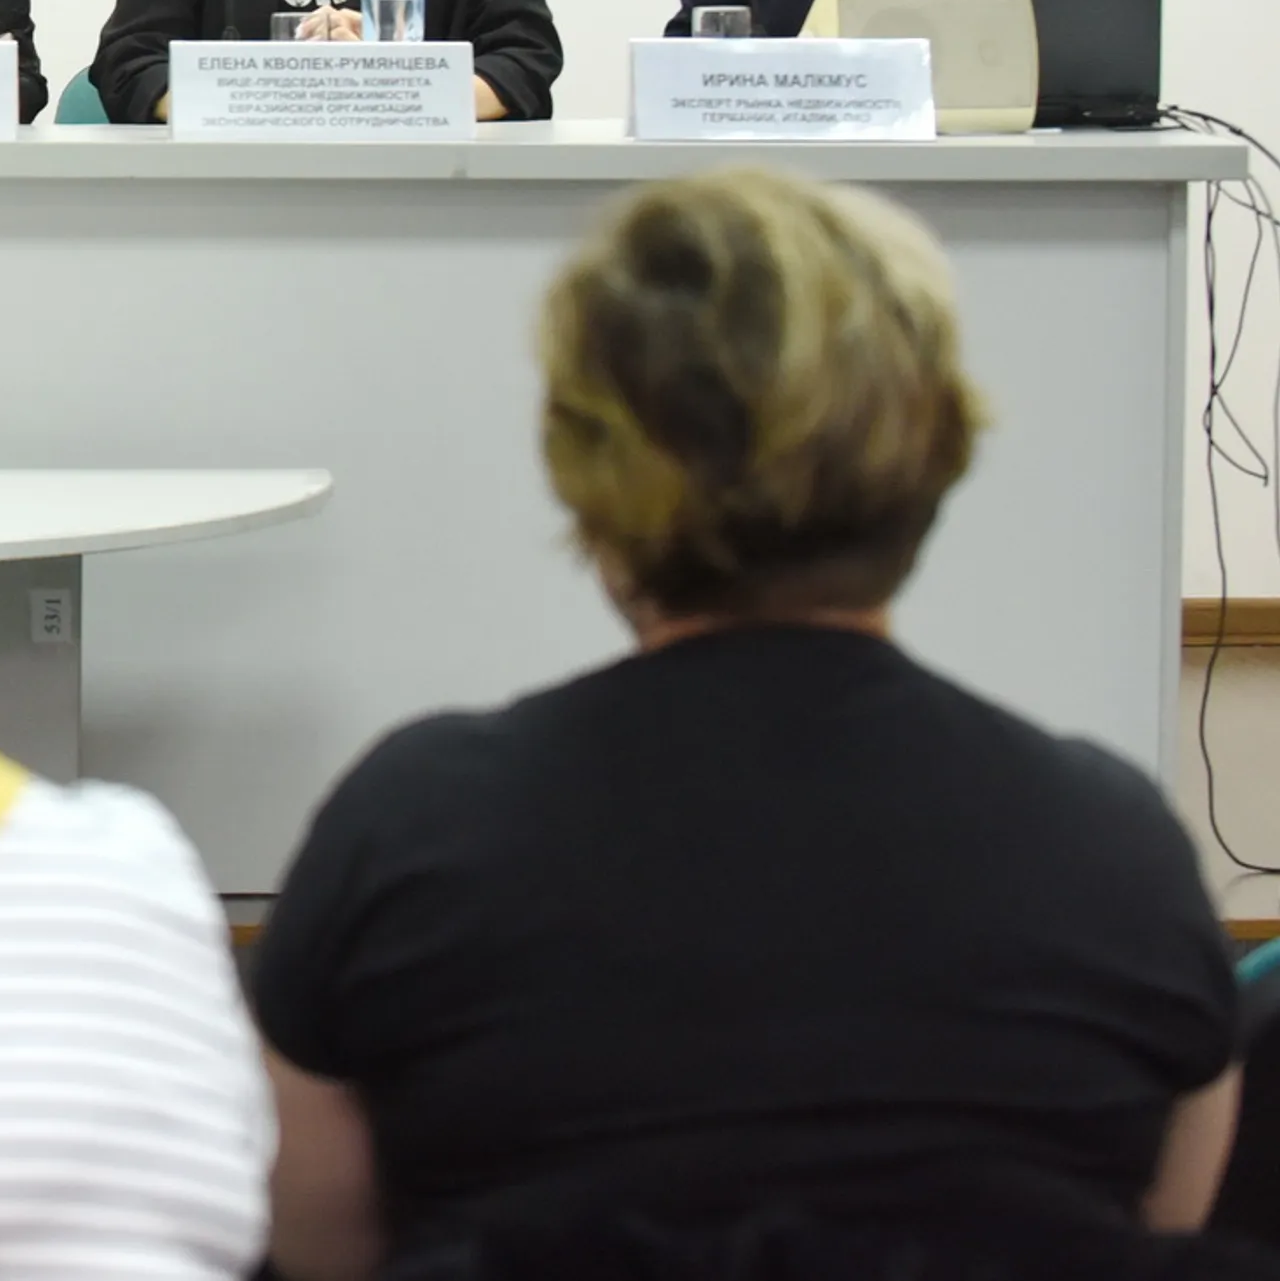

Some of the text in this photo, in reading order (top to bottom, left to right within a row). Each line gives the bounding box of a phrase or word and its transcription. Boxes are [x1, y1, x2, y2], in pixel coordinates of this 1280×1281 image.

[198, 57, 449, 72] ЕЛЕНА КВОЛЕК-РУМЯНЦЕВА
[702, 73, 867, 88] ИРИНА МАЛКМУС
